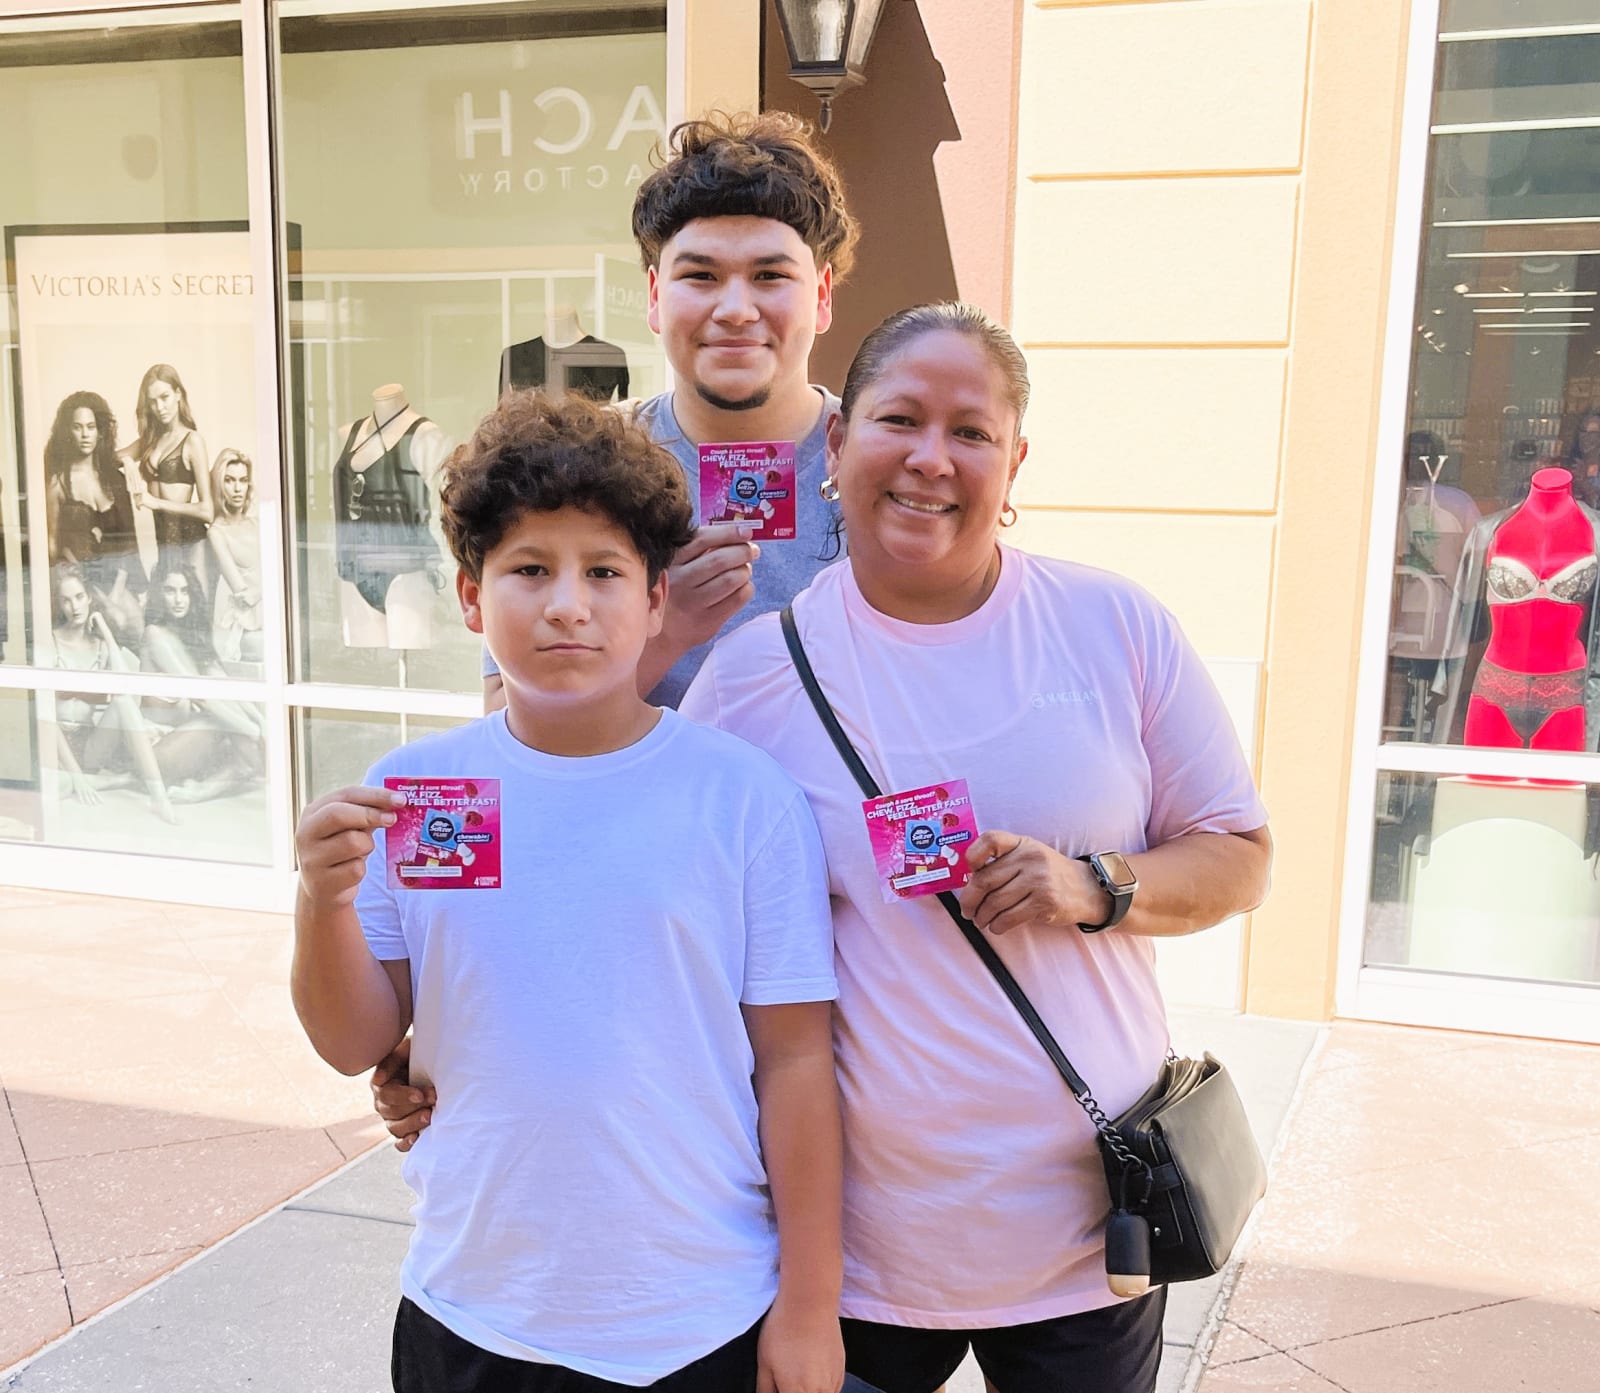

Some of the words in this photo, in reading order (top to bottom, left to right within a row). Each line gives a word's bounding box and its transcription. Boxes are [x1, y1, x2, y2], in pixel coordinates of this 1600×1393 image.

[31, 274, 162, 297] VICTORIA'S
[720, 460, 739, 468] FEEL
[740, 459, 770, 467] BETTER
[408, 798, 432, 806] FEEL
[433, 798, 470, 806] BETTER
[887, 811, 909, 821] FEEL
[910, 803, 943, 816] BETTER
[944, 796, 969, 807] FAST!
[474, 876, 479, 886] 4
